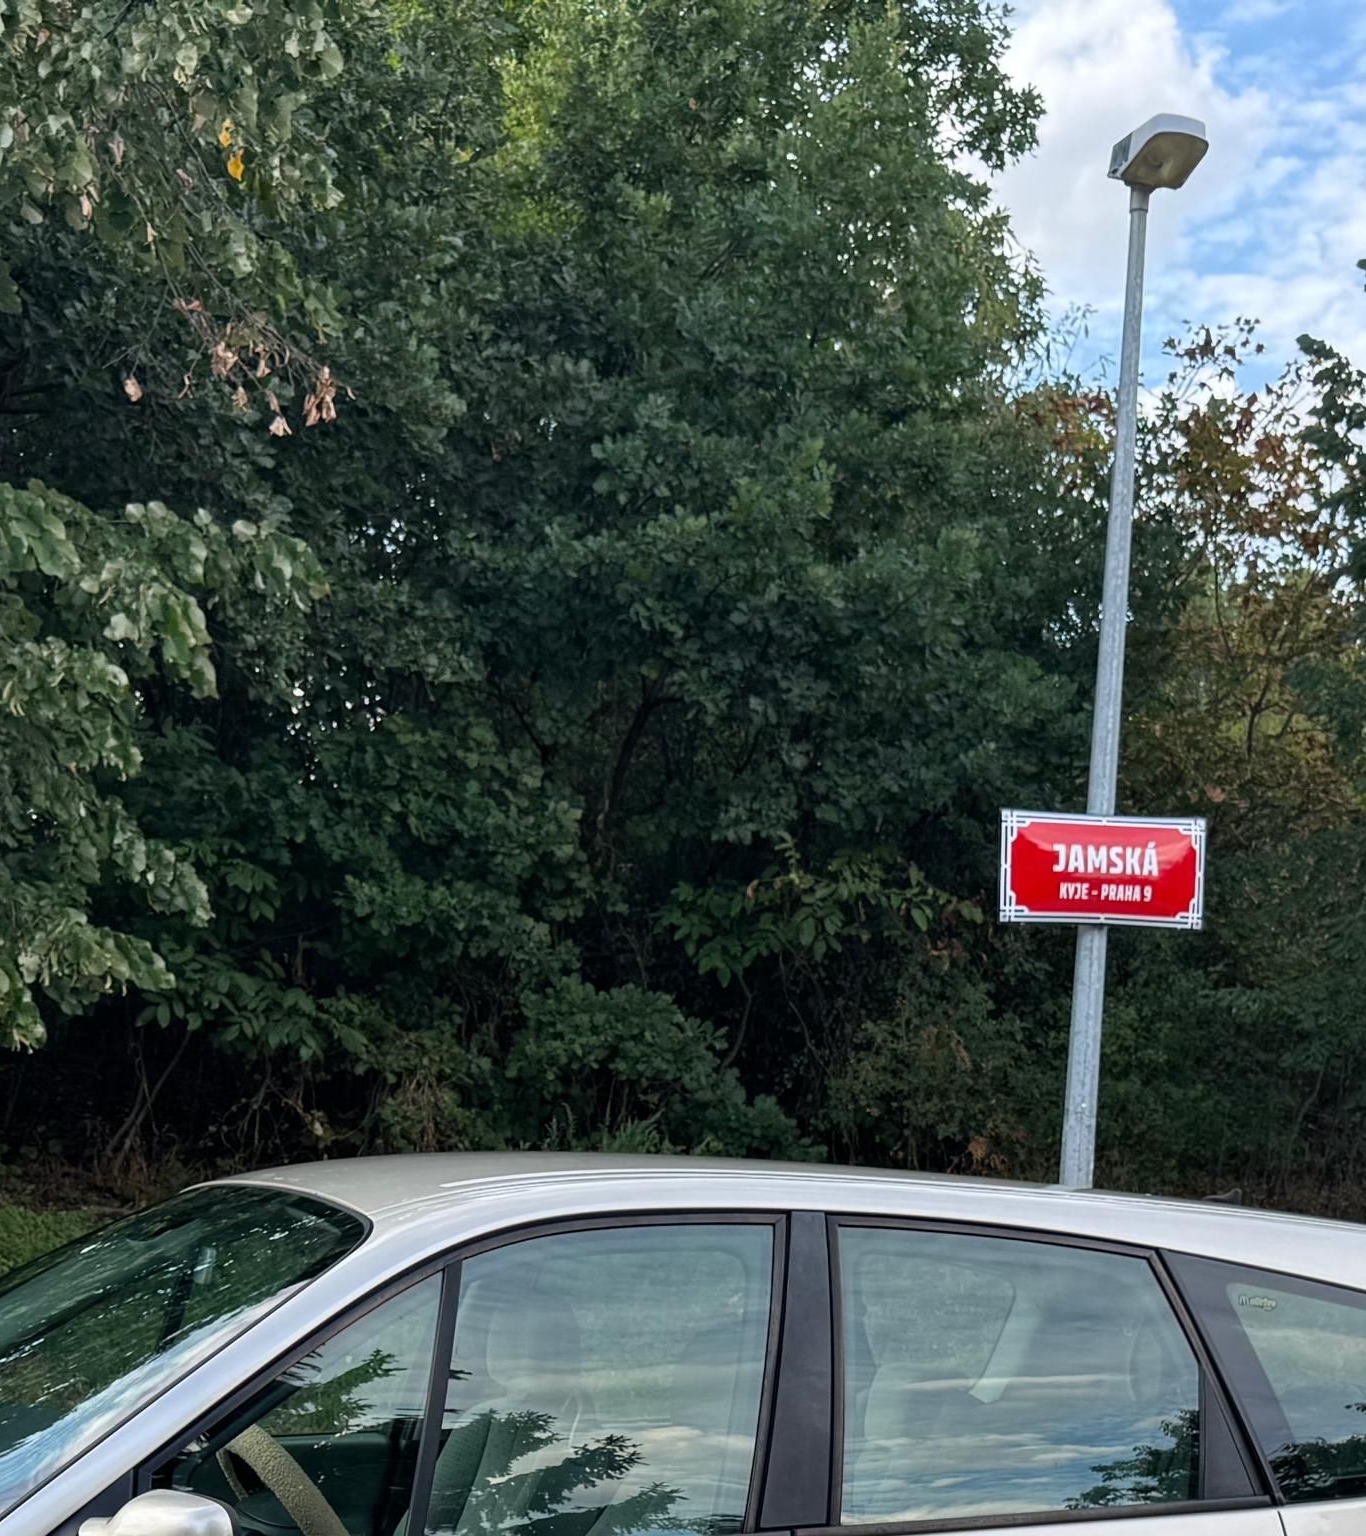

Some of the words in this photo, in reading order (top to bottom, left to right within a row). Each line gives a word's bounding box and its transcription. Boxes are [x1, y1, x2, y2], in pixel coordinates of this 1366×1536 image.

[1052, 843, 1159, 877] JAMSKÁ
[1059, 882, 1089, 900] KYJE
[1100, 884, 1142, 902] PRAHA
[1143, 885, 1153, 903] 9
